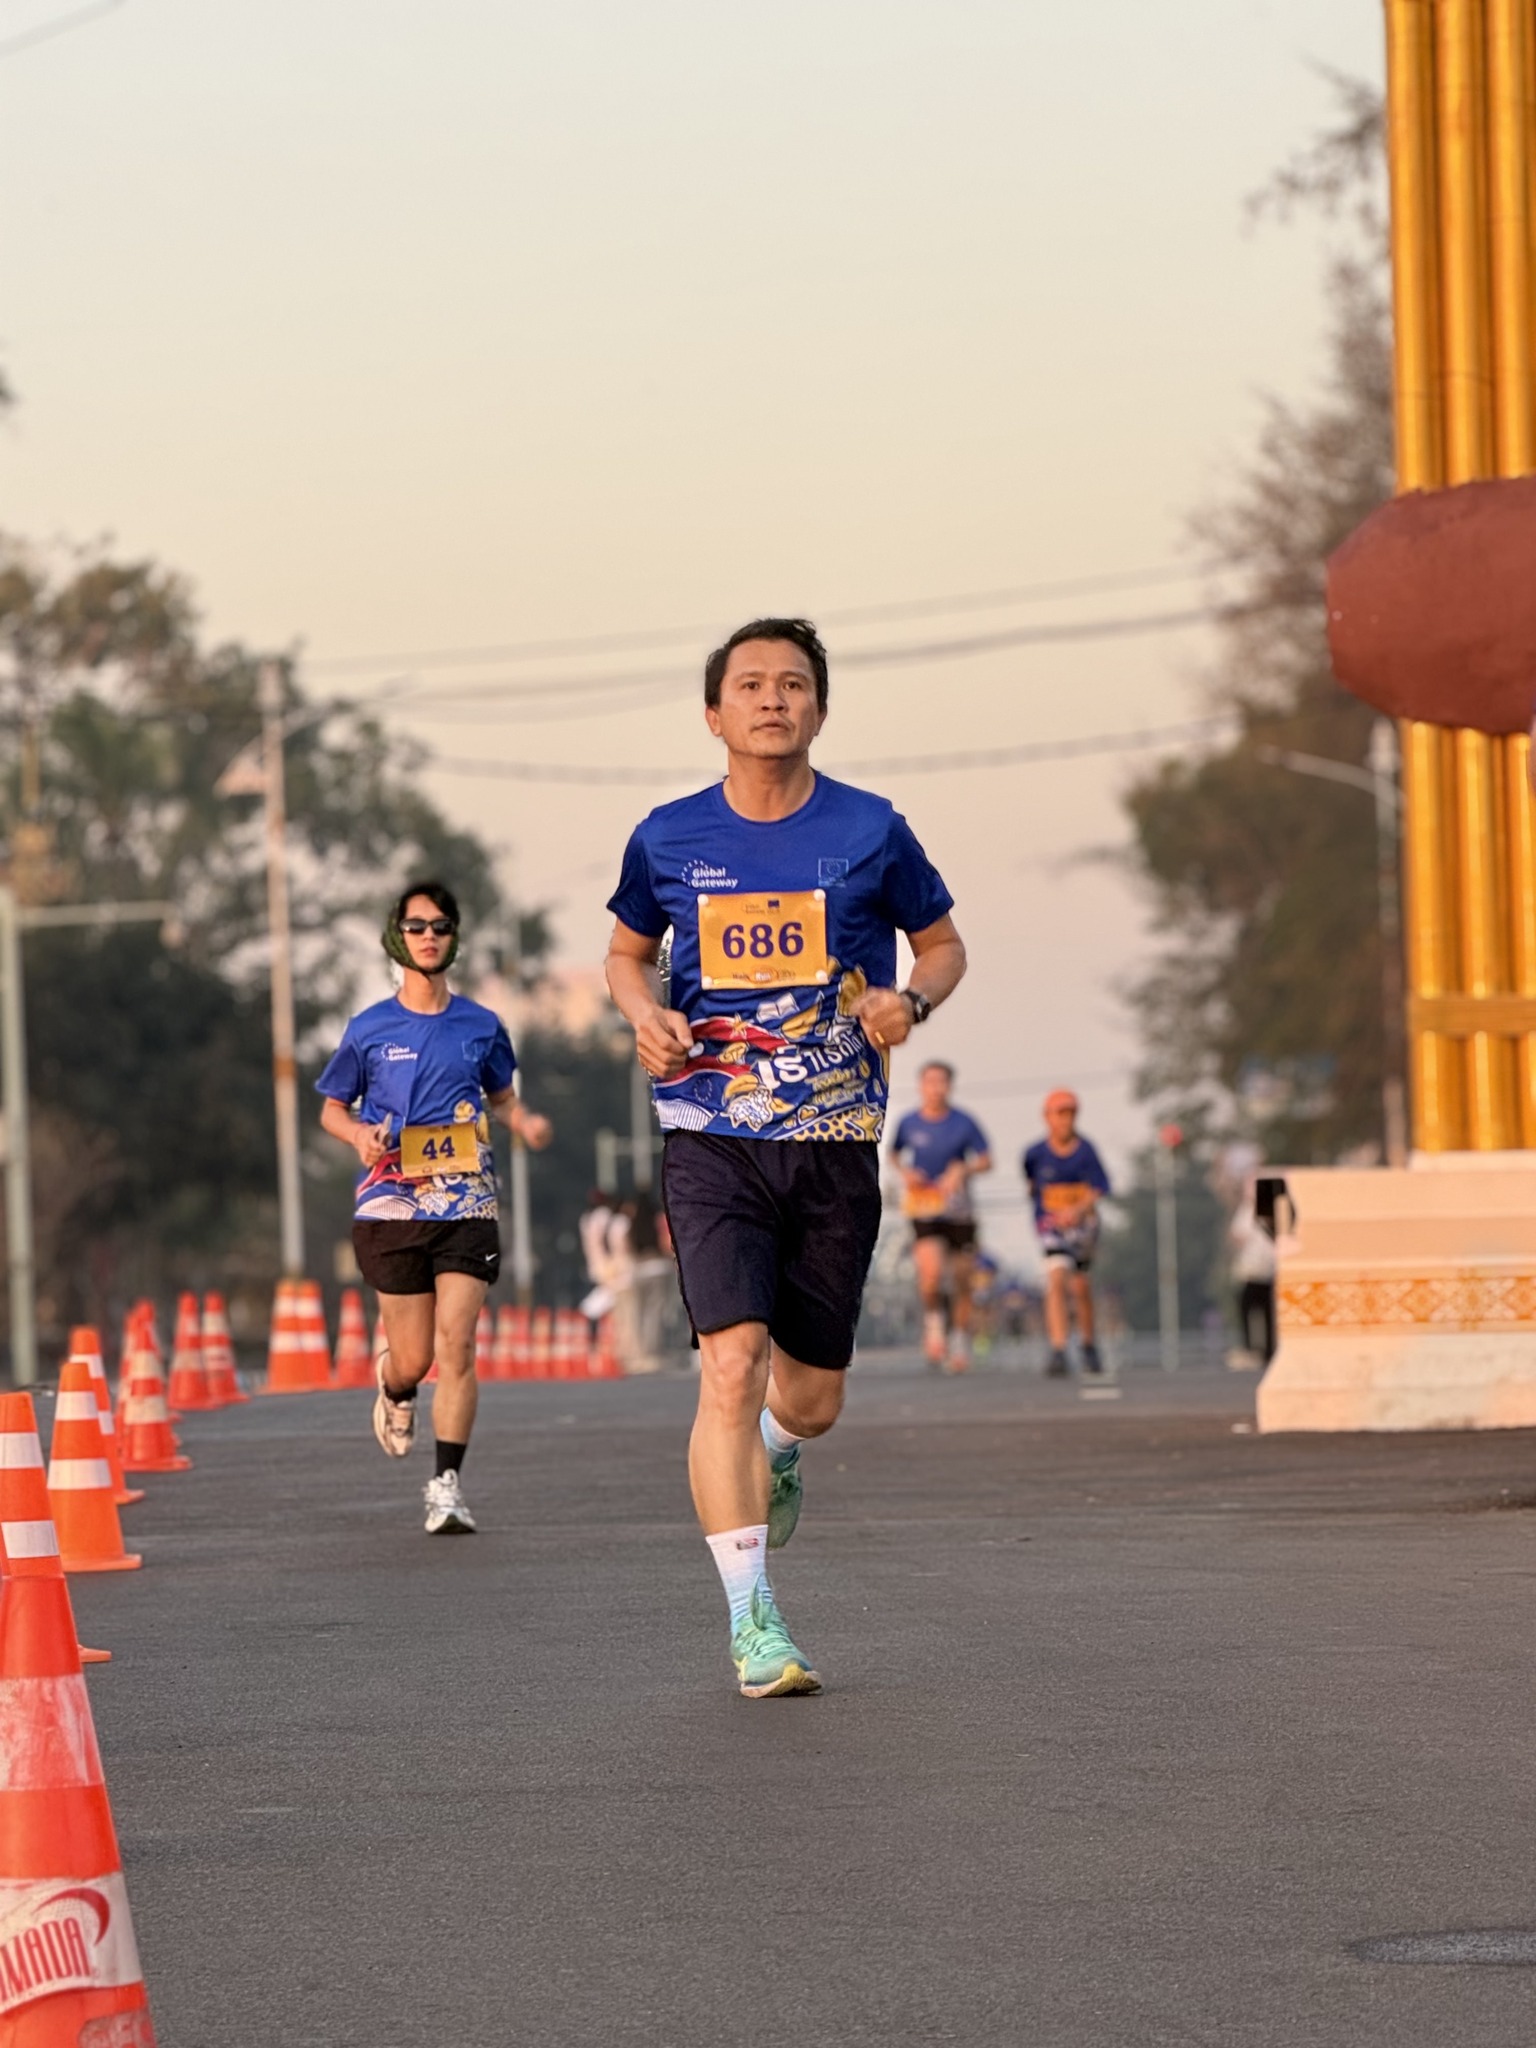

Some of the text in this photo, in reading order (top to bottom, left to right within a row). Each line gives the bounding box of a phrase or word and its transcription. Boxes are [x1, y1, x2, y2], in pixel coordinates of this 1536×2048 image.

[692, 867, 726, 878] Global
[691, 878, 738, 889] Gateway
[722, 922, 804, 959] 686
[388, 1046, 410, 1054] Global
[388, 1053, 418, 1061] Gateway
[422, 1136, 455, 1160] 44
